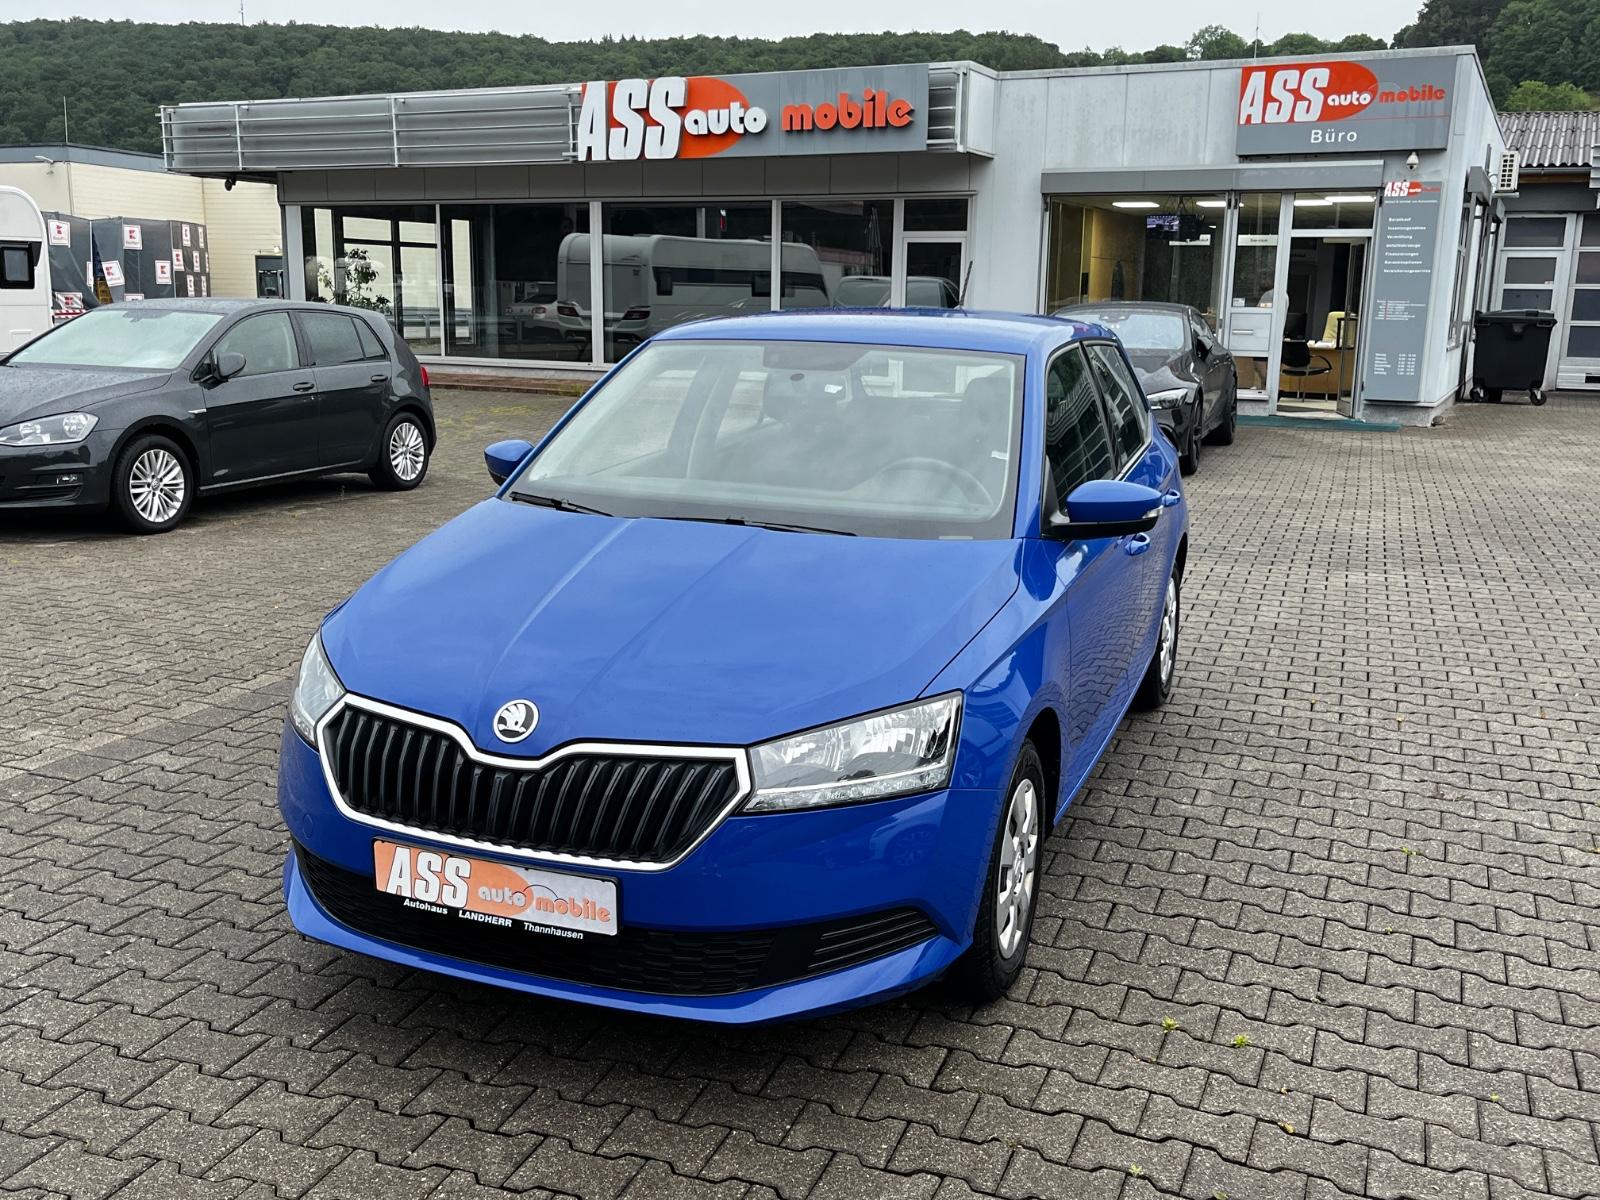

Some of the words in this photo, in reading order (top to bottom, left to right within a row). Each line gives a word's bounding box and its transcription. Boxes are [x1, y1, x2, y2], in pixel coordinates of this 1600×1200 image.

[578, 76, 687, 162] ASS
[684, 101, 768, 135] auto
[781, 87, 915, 131] mobile
[1239, 68, 1330, 125] ASS
[1327, 90, 1372, 106] auto
[1379, 84, 1446, 104] mobile
[1310, 129, 1358, 143] Büro
[1384, 181, 1410, 197] ASS
[386, 846, 472, 909] ASS
[478, 885, 528, 908] auto
[535, 895, 611, 924] mobile
[403, 898, 449, 916] Autohaus
[458, 909, 513, 928] LANDHERR
[523, 921, 584, 940] Thannhausen
